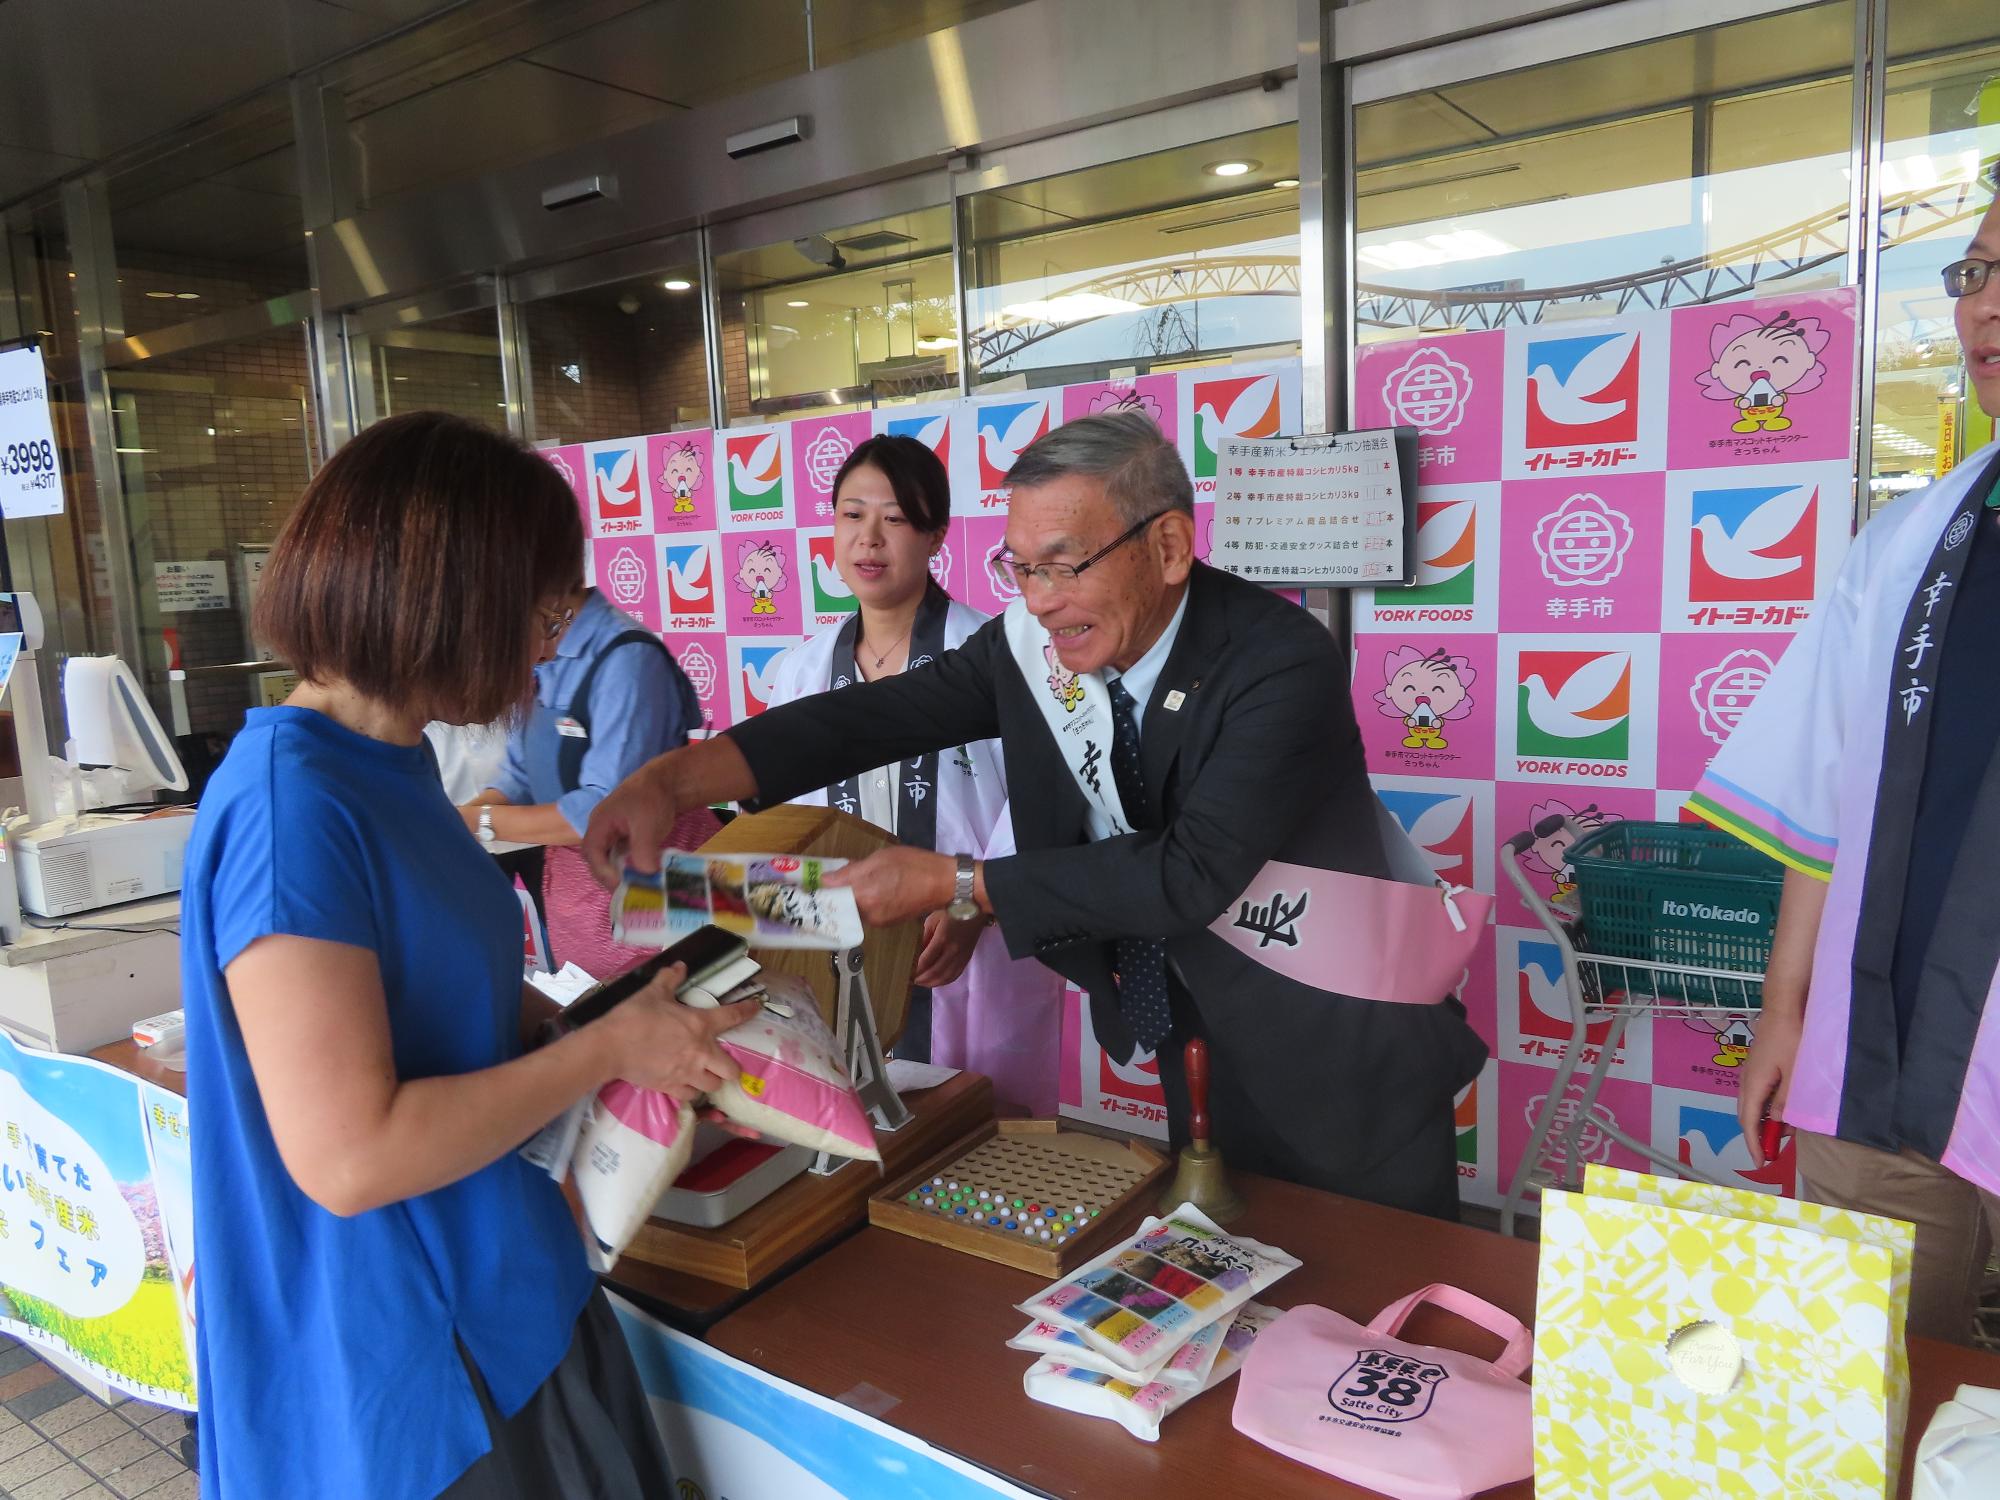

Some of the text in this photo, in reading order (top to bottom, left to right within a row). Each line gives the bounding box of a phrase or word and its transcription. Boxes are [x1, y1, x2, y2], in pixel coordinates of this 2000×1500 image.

[1708, 434, 1809, 449] 幸手市マスコットキャラクター
[1734, 447, 1780, 456] さっちゃん
[1524, 448, 1637, 471] イトーヨーカドー
[1228, 467, 1242, 477] 1等
[1226, 491, 1241, 501] 2等
[731, 511, 784, 523] YORK FOODS
[1225, 516, 1240, 526] 3等
[600, 520, 643, 533] イトーヨーカドー
[1224, 540, 1239, 550] 4等
[1545, 596, 1615, 619] 幸手市
[815, 615, 838, 625] YORK
[1373, 608, 1474, 622] YORK FOODS
[1687, 606, 1810, 625] イトーヨーカドー
[670, 617, 716, 629] イトーヨーカドー
[1899, 570, 1953, 727] 幸手市
[1404, 760, 1441, 769] さっちゃん
[1516, 760, 1628, 778] YORK FOODS
[1233, 889, 1310, 948] 長
[153, 1103, 190, 1139] 幸せ
[1345, 1368, 1421, 1406] 38
[1340, 1397, 1403, 1419] Satte City
